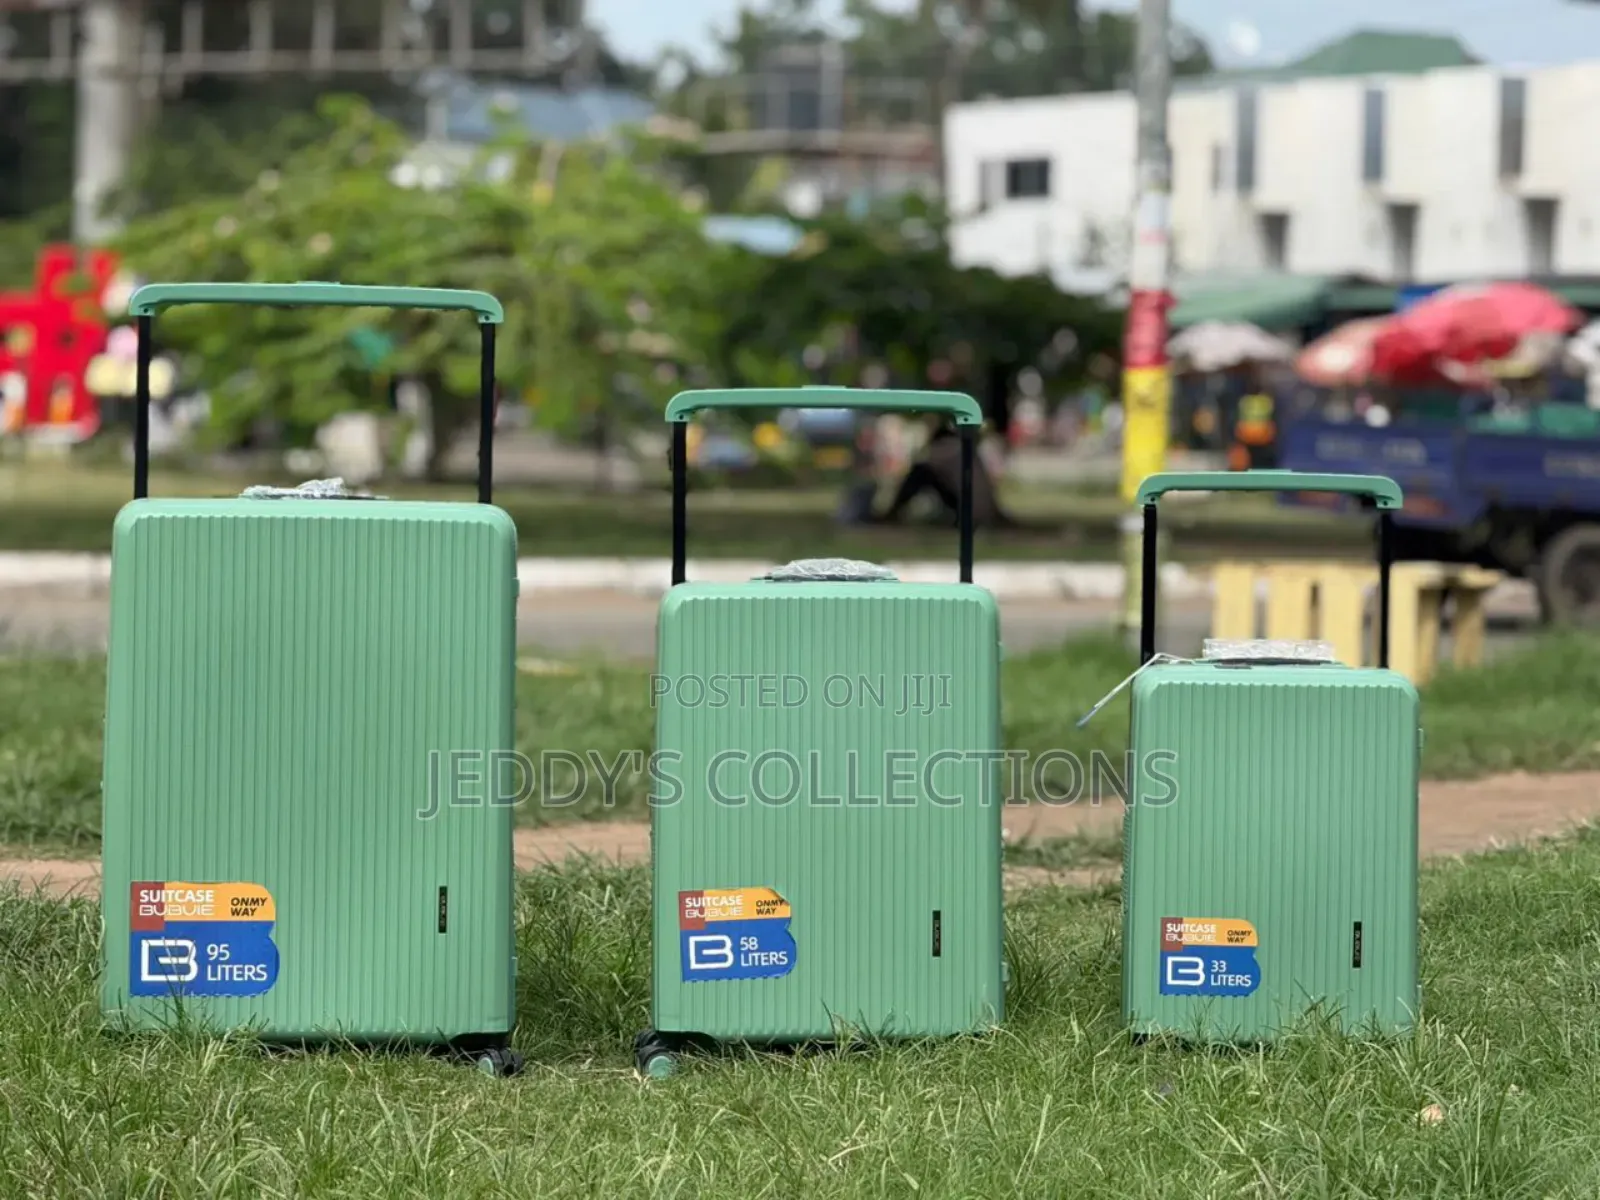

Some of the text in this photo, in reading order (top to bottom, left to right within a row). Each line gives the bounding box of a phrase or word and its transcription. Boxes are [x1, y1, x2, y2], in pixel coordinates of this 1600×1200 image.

[139, 889, 215, 903] SUITCASE
[230, 897, 268, 907] ONMY
[685, 895, 744, 908] SUITCASE
[139, 904, 215, 916] BUBUIE
[230, 907, 257, 917] WAY
[755, 907, 777, 915] WAY
[1166, 923, 1217, 933] SUITCASE
[740, 936, 758, 951] 58
[206, 943, 230, 961] 95
[740, 951, 788, 967] LITERS
[206, 964, 268, 982] LITERS
[1210, 960, 1227, 973] 33
[1210, 974, 1252, 987] LITERS
